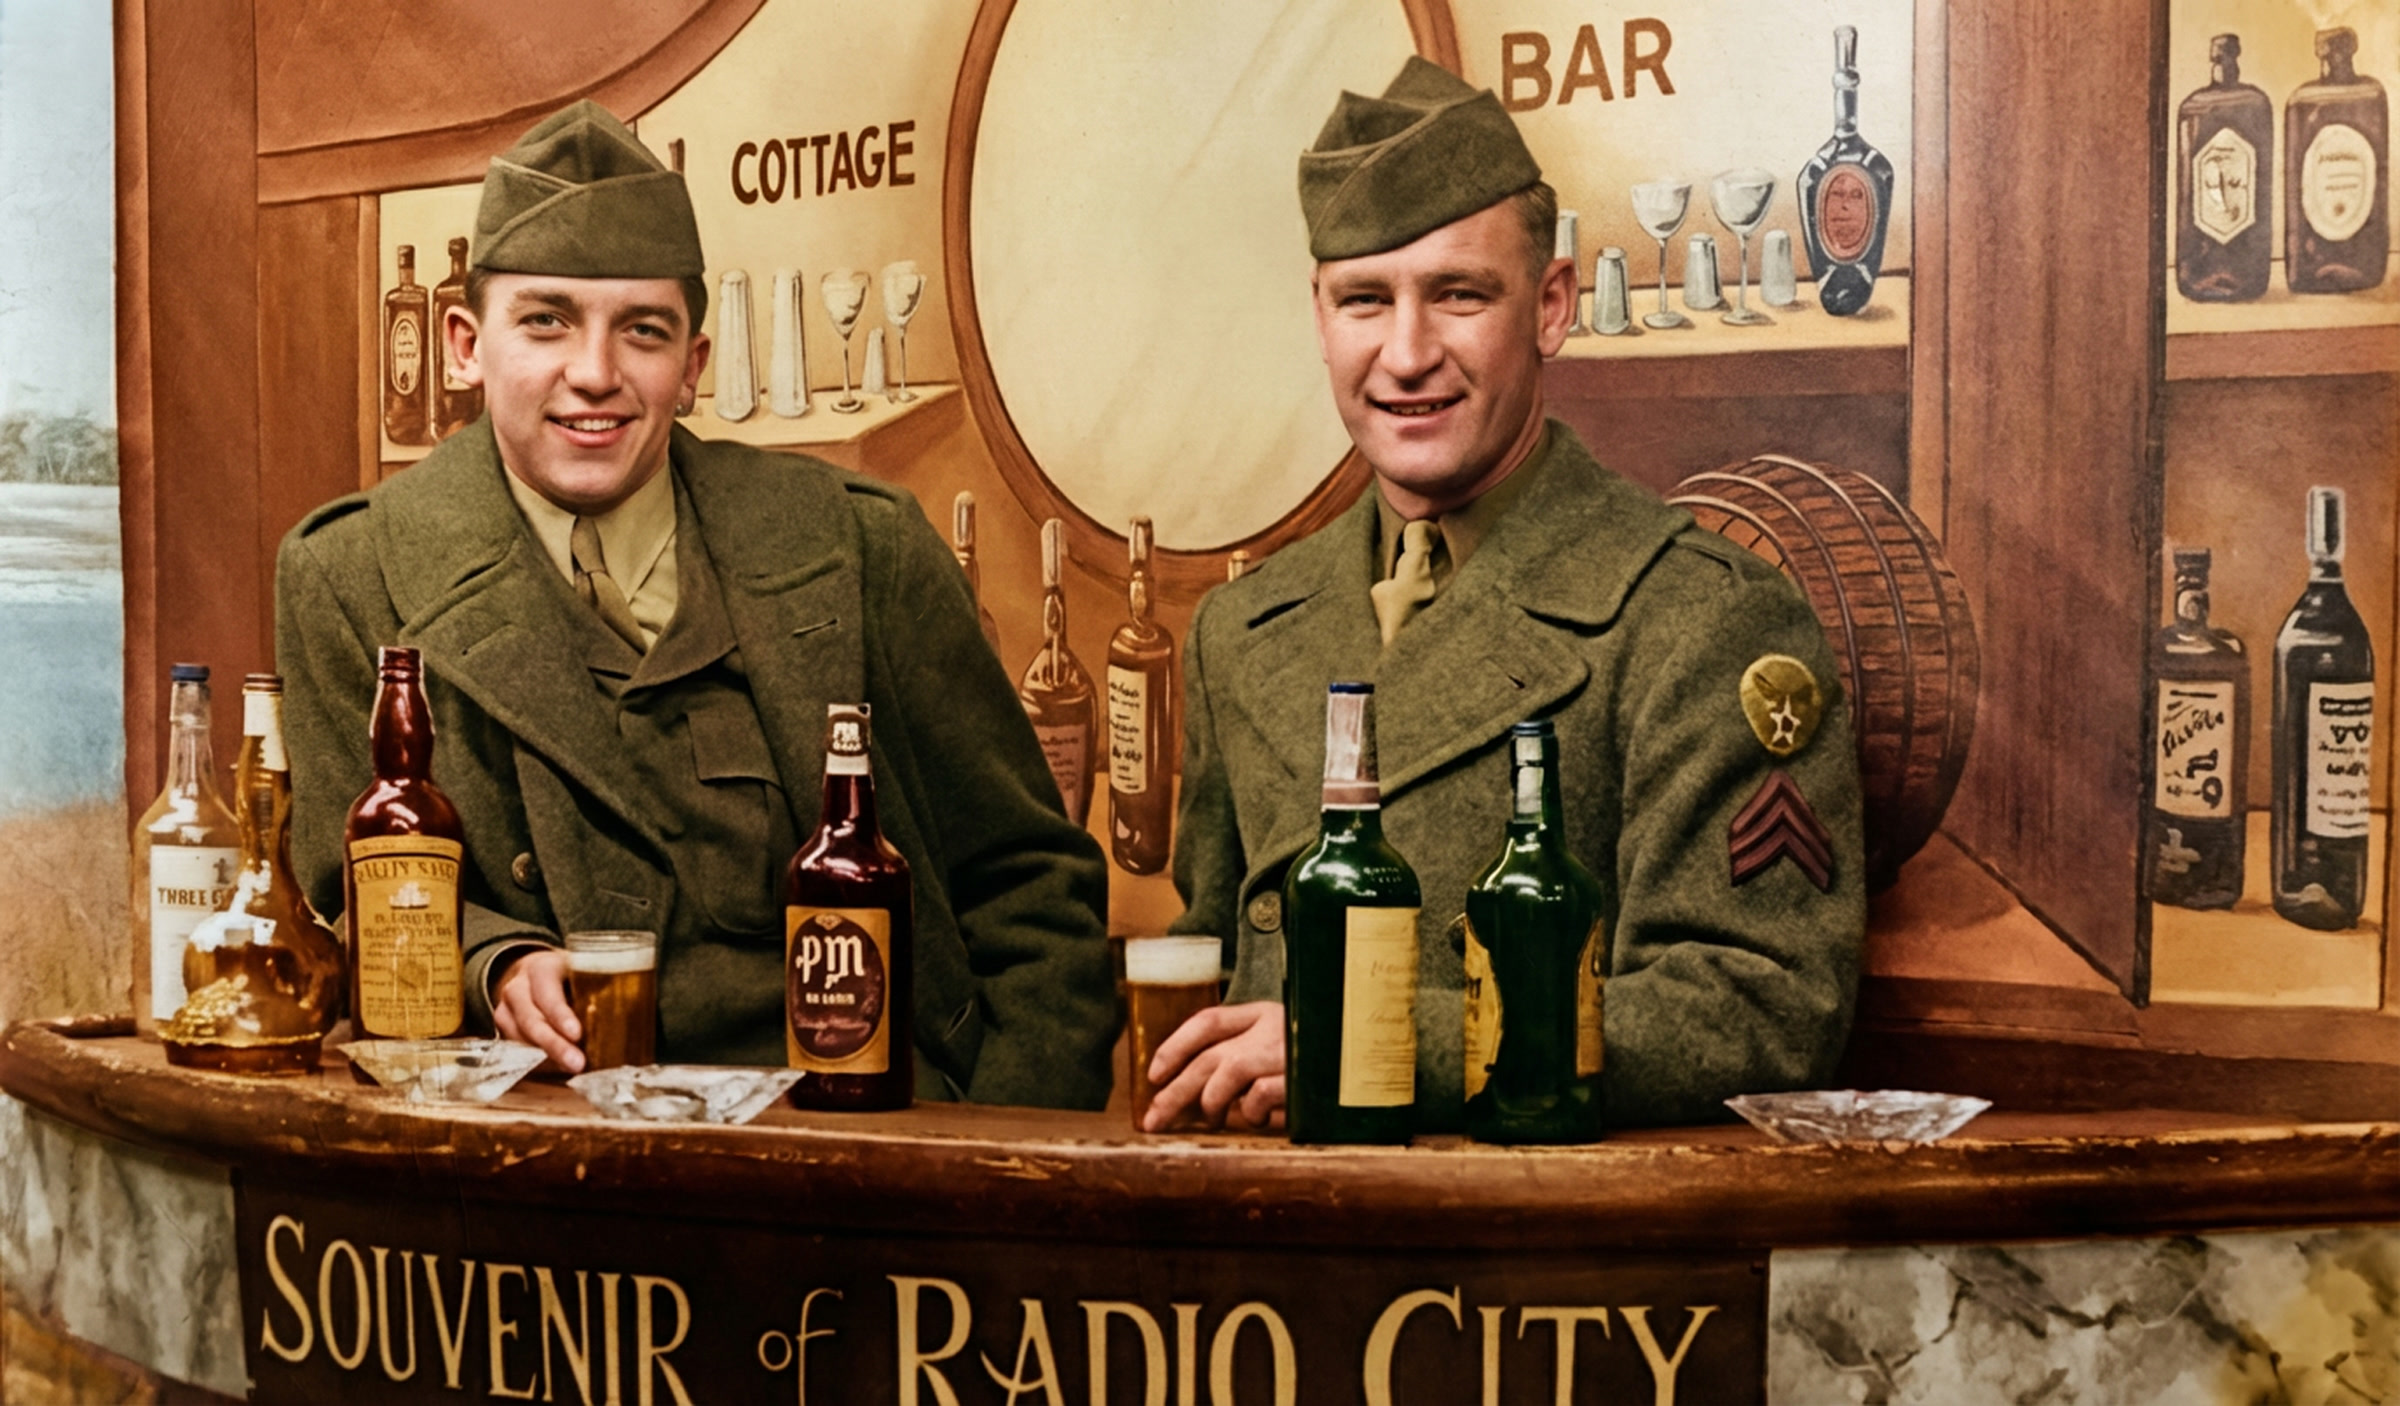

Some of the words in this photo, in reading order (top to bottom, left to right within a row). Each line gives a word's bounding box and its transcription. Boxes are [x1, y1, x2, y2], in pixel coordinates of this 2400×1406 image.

[1501, 17, 1676, 113] BAR
[731, 119, 915, 205] COTTAGE
[261, 1214, 698, 1406] SOUVENIR
[757, 1287, 843, 1406] of
[886, 1275, 1298, 1406] RADIO
[1362, 1285, 1721, 1406] CITY
